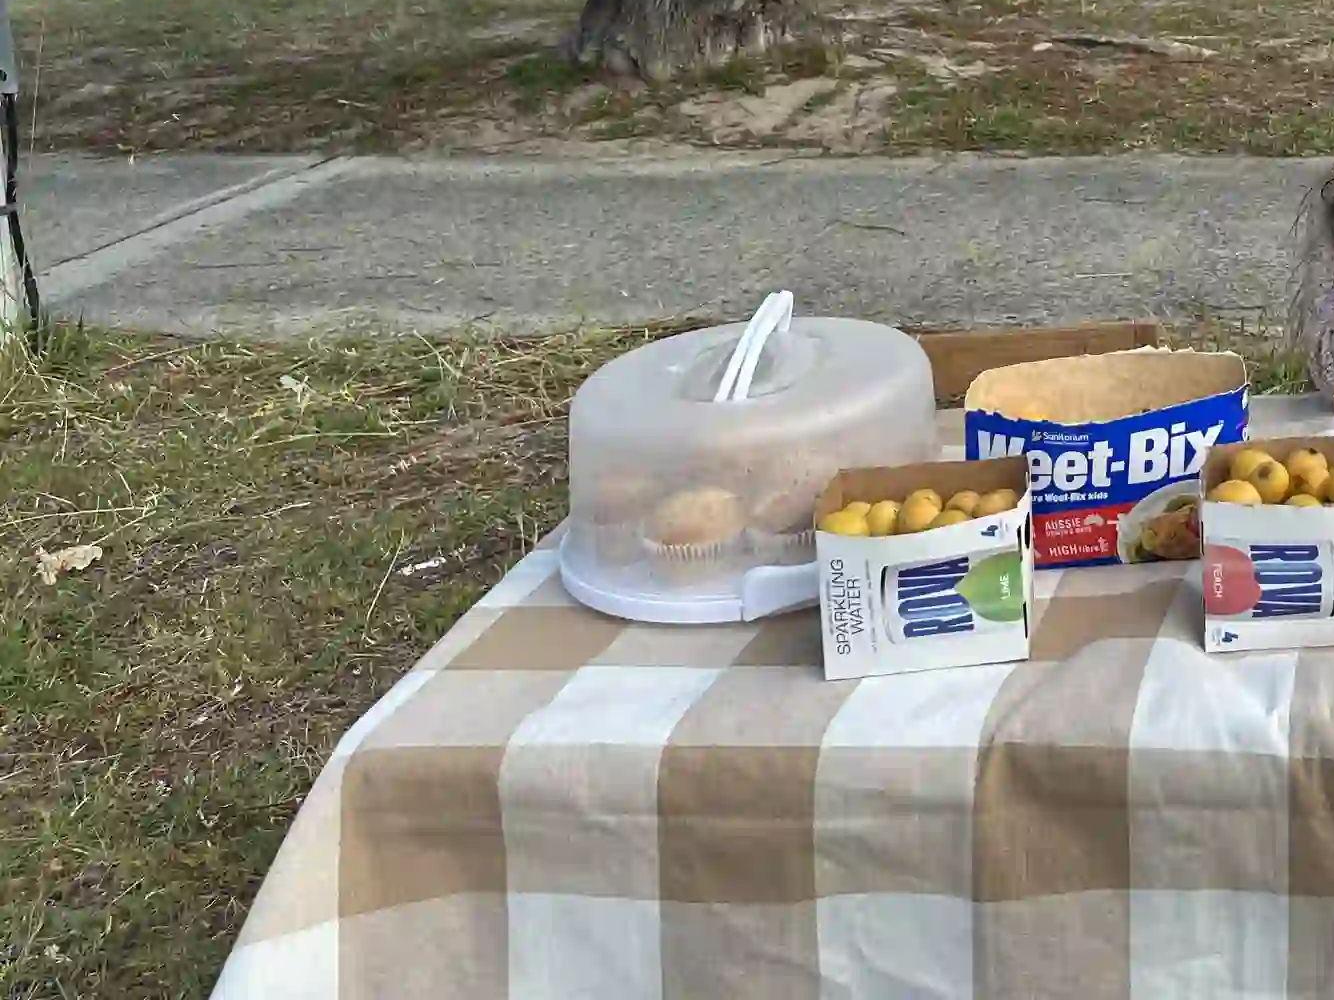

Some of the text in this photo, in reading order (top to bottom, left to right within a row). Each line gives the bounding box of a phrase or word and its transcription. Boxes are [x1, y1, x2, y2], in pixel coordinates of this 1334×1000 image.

[829, 558, 851, 656] SPARKLING
[846, 576, 866, 636] WATER
[1000, 573, 1012, 600] LIME
